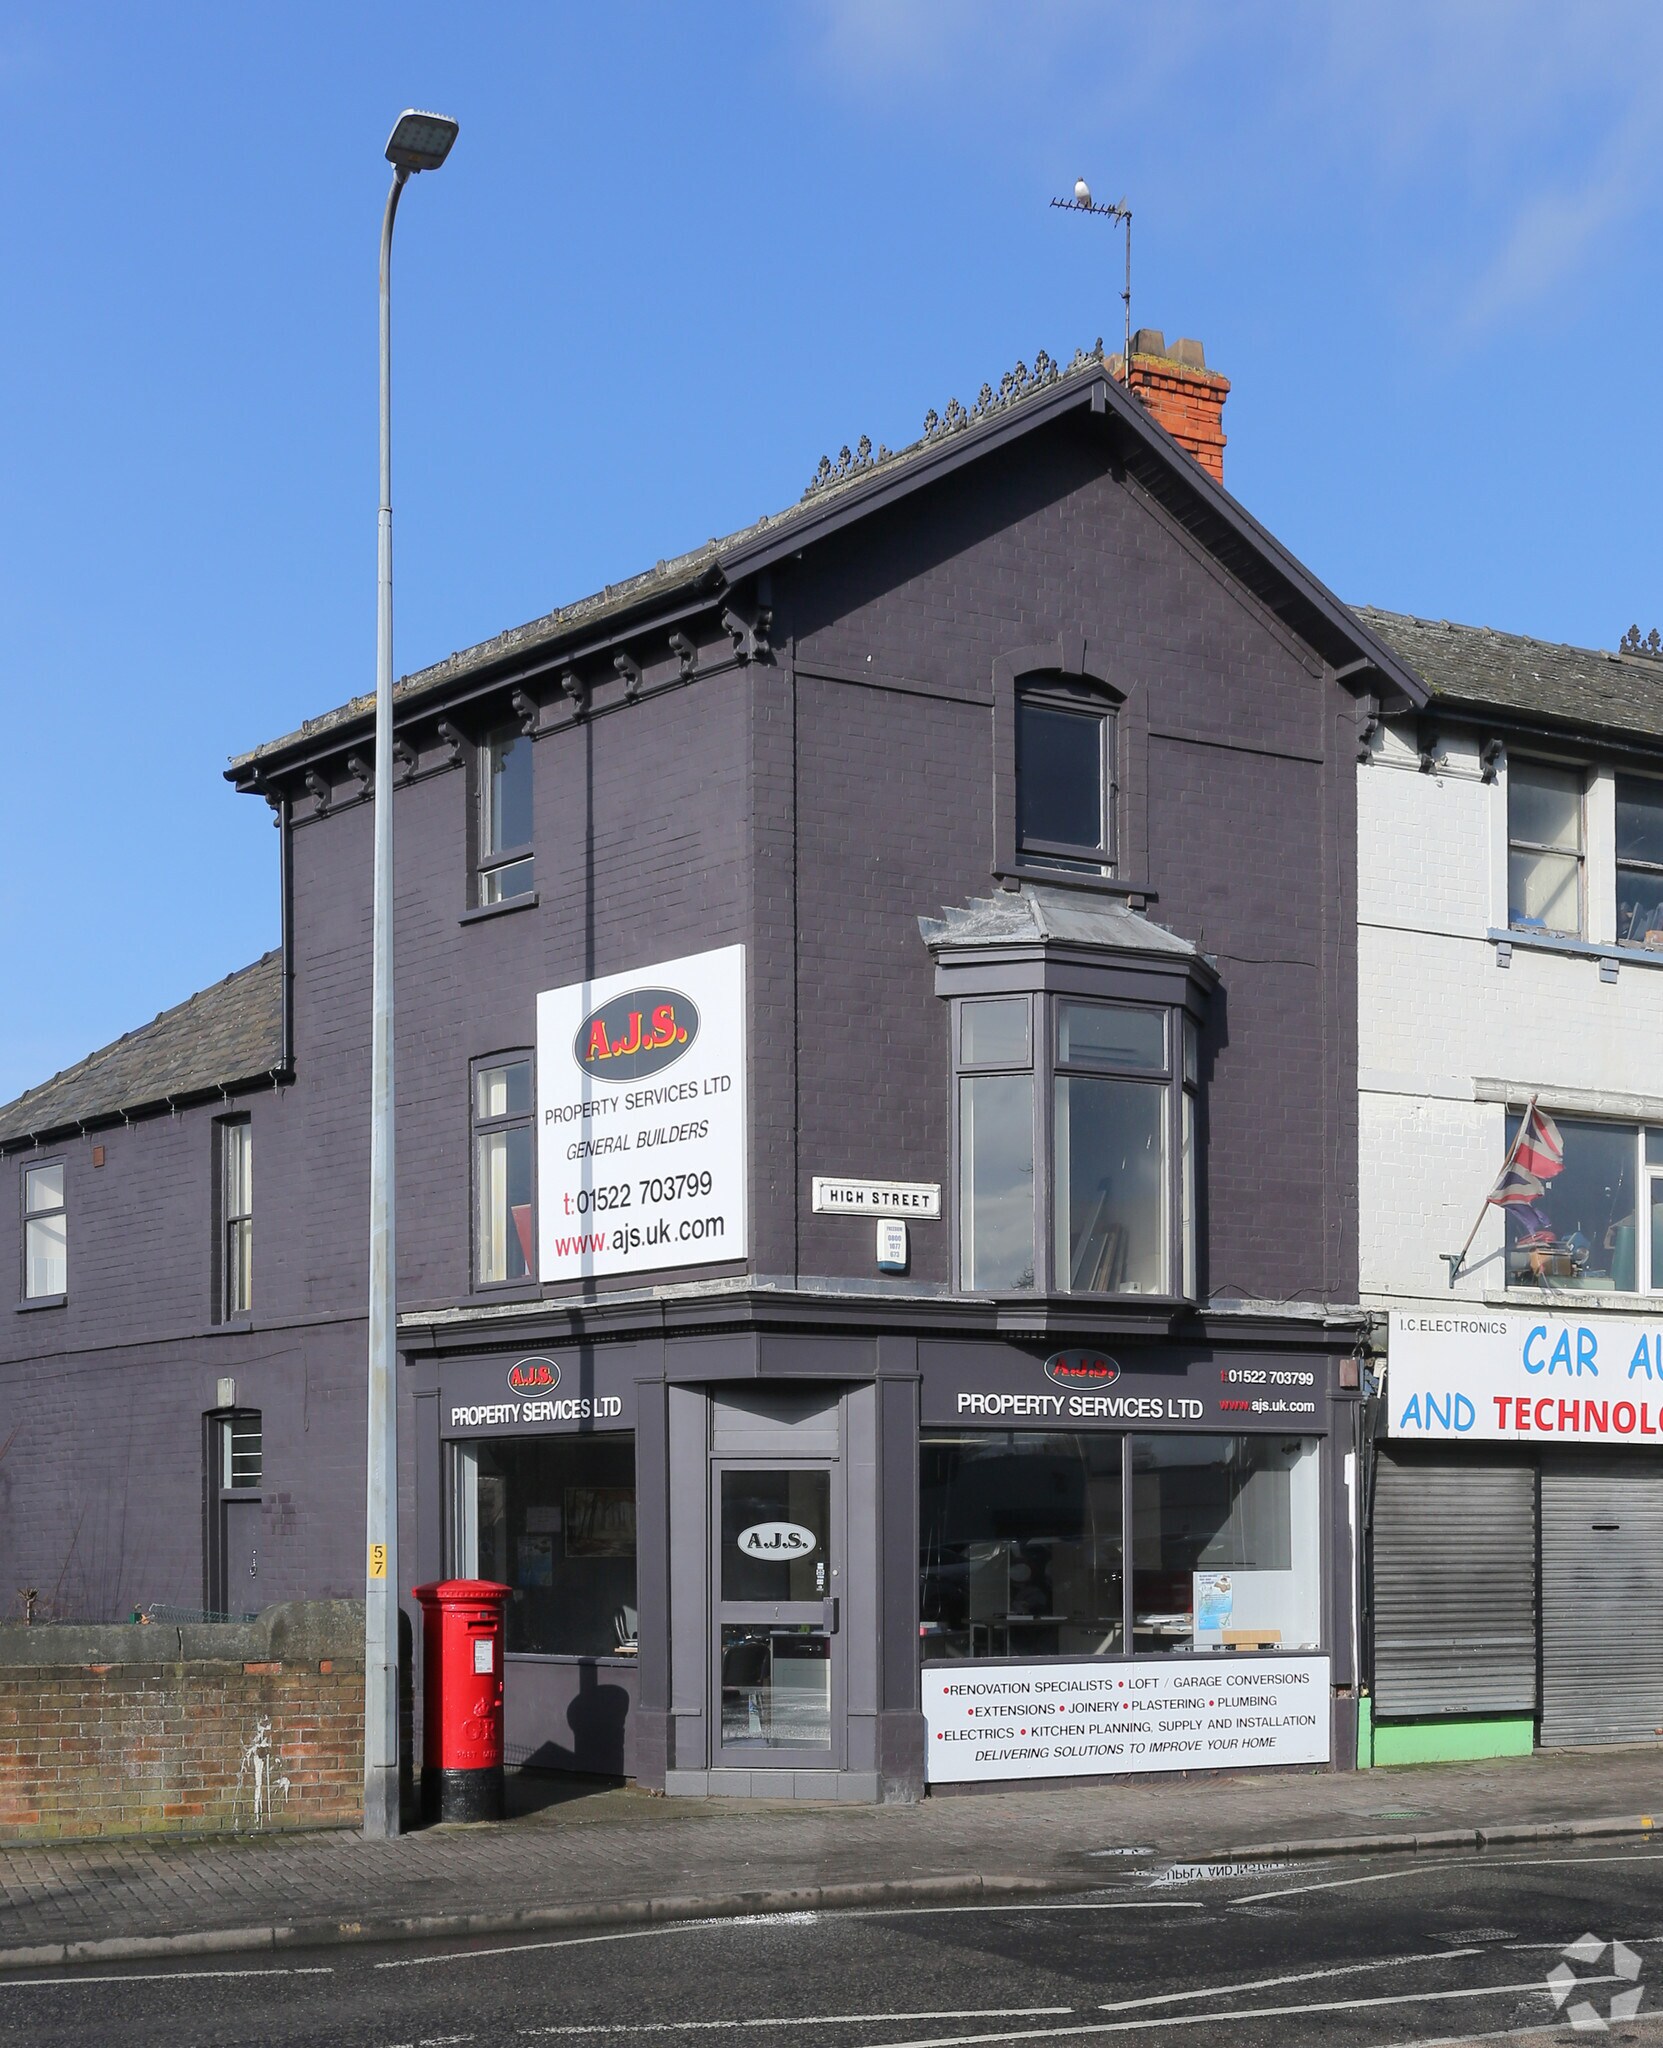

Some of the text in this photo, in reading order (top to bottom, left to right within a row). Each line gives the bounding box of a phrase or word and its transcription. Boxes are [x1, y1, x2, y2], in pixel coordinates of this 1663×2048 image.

[584, 1003, 689, 1061] A.J.S.
[545, 1074, 732, 1125] PROPERTY SERVICES LTD
[566, 1119, 709, 1160] GENERAL BUILDERS
[638, 1170, 713, 1204] 703799
[830, 1189, 930, 1208] HIGH STREET
[555, 1215, 726, 1257] www.ajs.uk.com
[1523, 1325, 1599, 1377] CAR
[511, 1365, 555, 1387] A.J.S.
[1053, 1353, 1116, 1380] A.J.S.
[1269, 1370, 1314, 1386] 703799
[451, 1396, 623, 1427] PROPERTY SERVICES LTD
[957, 1392, 1204, 1420] PROPERTY SERVICES LTD
[1219, 1398, 1316, 1414] www.ajs.uk.com
[1400, 1391, 1663, 1435] AND TECHNOL
[373, 1545, 383, 1559] 5
[747, 1532, 809, 1549] A.J.S.
[374, 1562, 383, 1575] 7
[950, 1682, 1031, 1696] RENOVATION
[1034, 1679, 1114, 1693] SPECIALISTS
[1128, 1677, 1160, 1689] LOFT
[1173, 1675, 1223, 1688] GARAGE
[1226, 1673, 1311, 1687] CONVERSIONS
[975, 1695, 1278, 1718] EXTENSIONS JOINERY PLASTERING PLUMBING
[944, 1714, 1317, 1742] ELECTRICS KITCHEN PLANNING, SUPPLY AND INSTALLATION
[975, 1737, 1278, 1762] DELIVERING SOLUTIONS TO IMPROVE YOUR HOME
